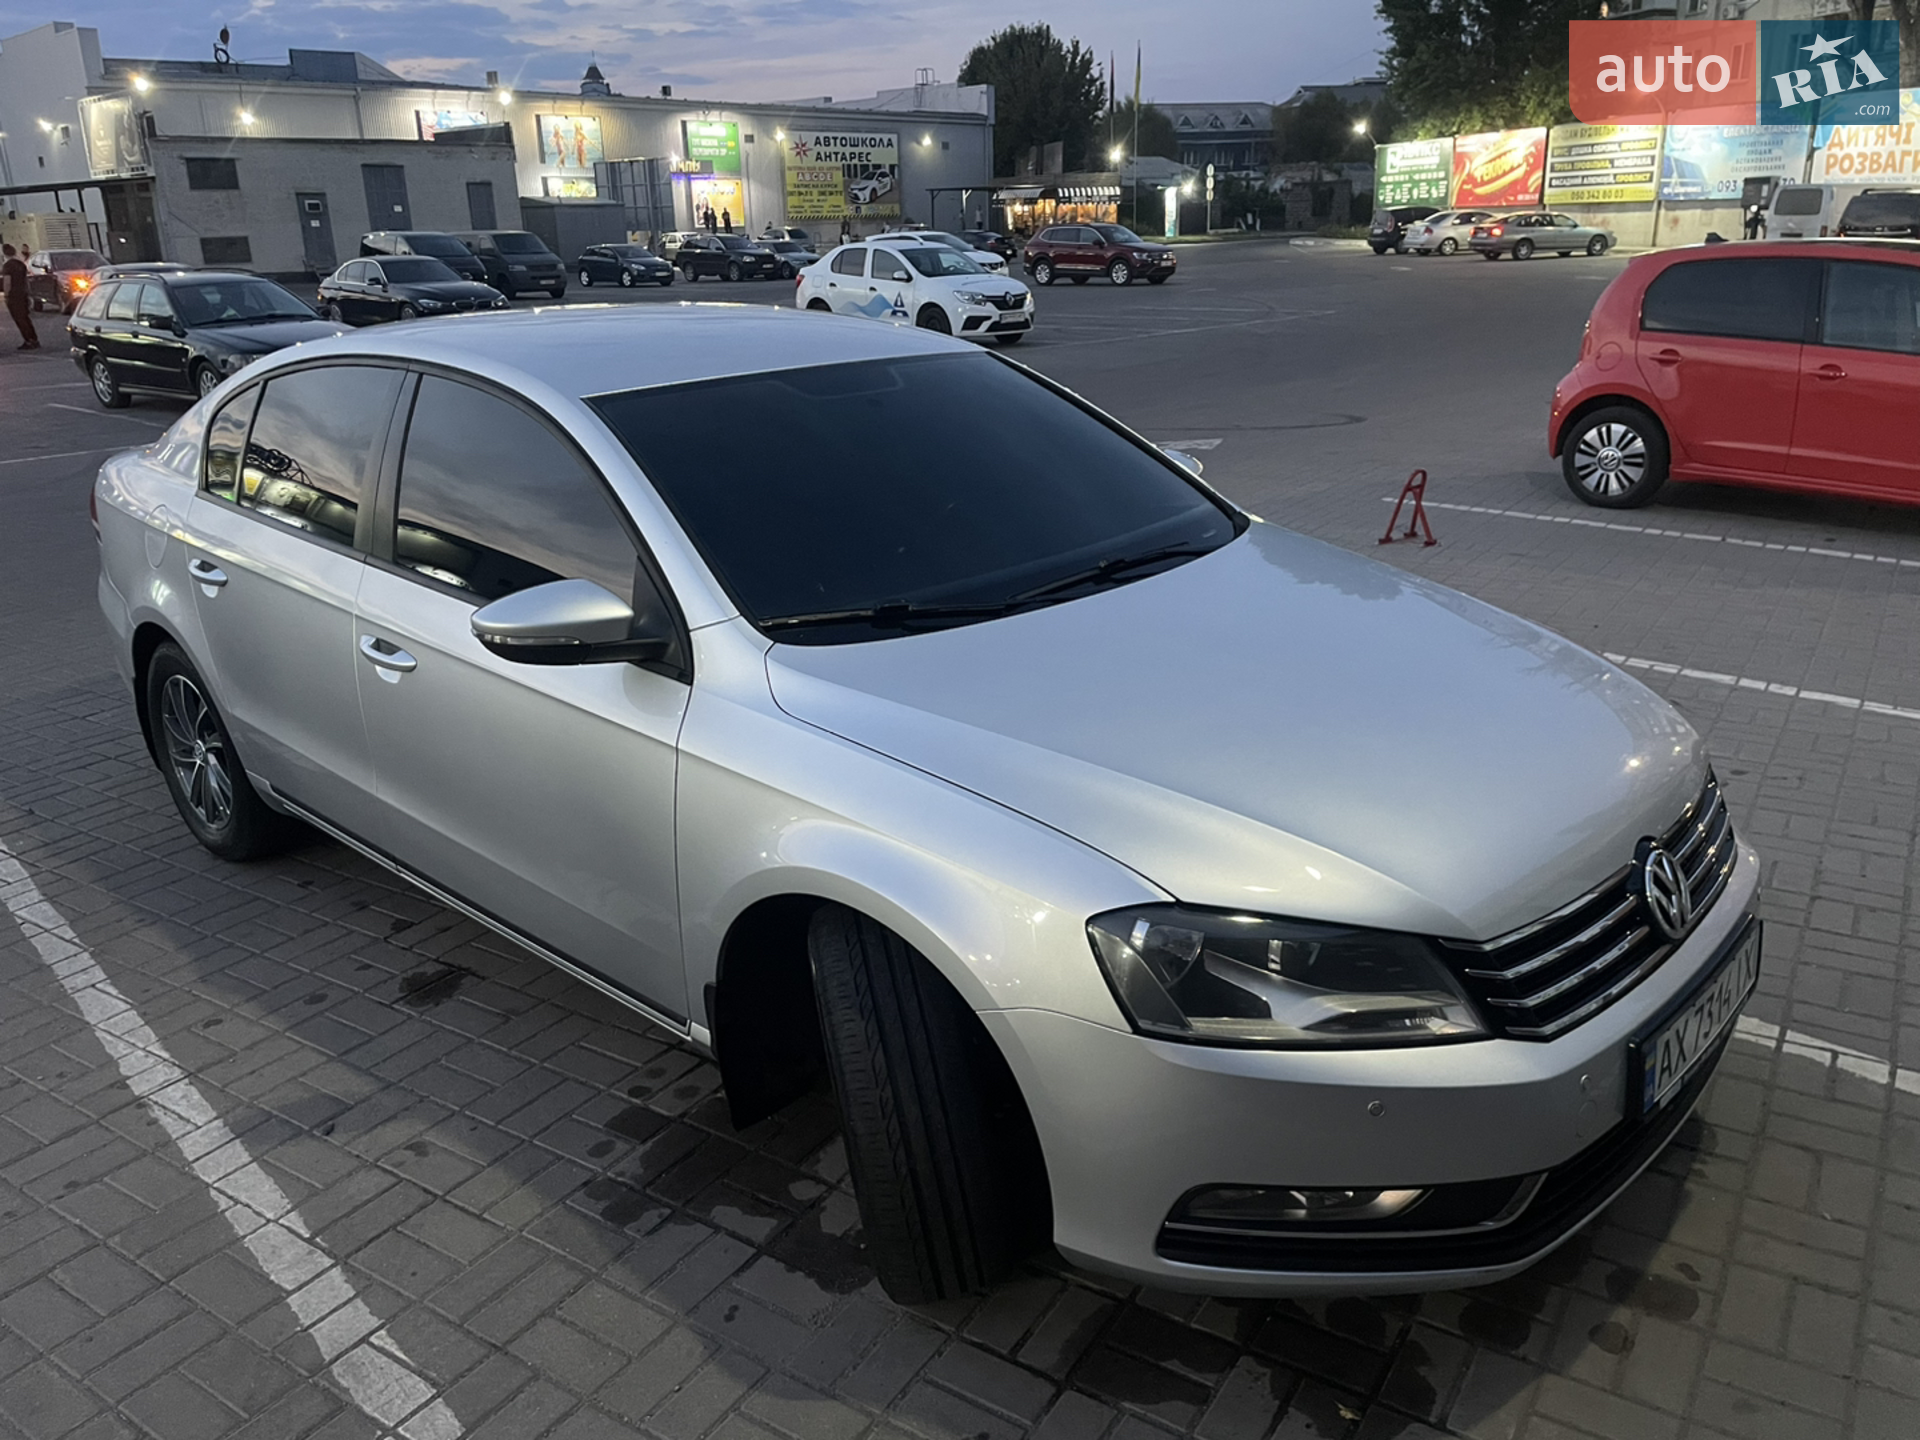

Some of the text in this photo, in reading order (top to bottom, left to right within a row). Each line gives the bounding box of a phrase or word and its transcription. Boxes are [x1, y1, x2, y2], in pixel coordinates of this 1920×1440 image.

[814, 135, 894, 149] АВТОШКОЛА
[1826, 122, 1915, 152] ДИТЯЧІ
[815, 151, 873, 163] АНТАРЕС
[1746, 148, 1772, 156] ПРОДАЖ
[1717, 180, 1738, 193] 093
